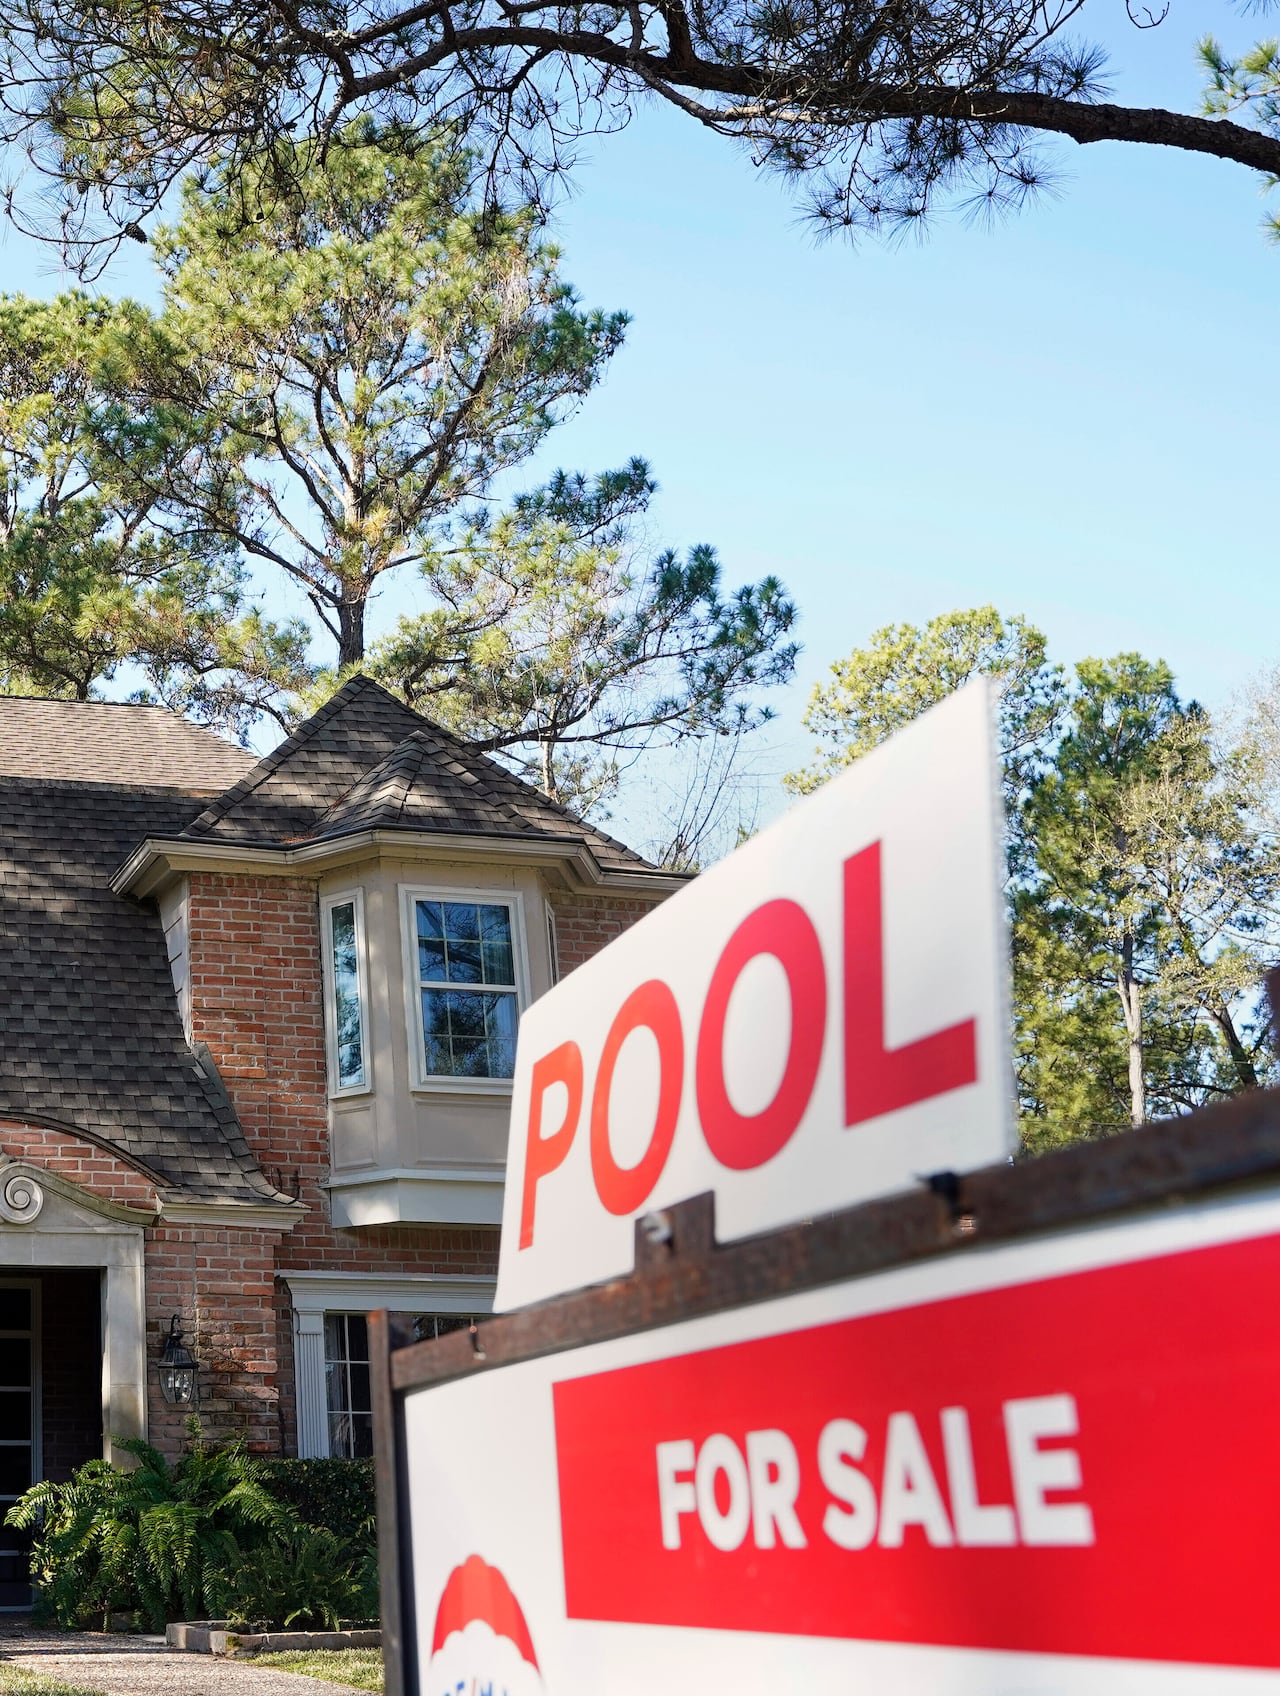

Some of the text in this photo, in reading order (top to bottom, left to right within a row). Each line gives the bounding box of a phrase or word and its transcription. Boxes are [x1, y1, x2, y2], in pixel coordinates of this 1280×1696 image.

[518, 841, 978, 1252] POOL
[655, 1394, 1096, 1552] FOR SALE
